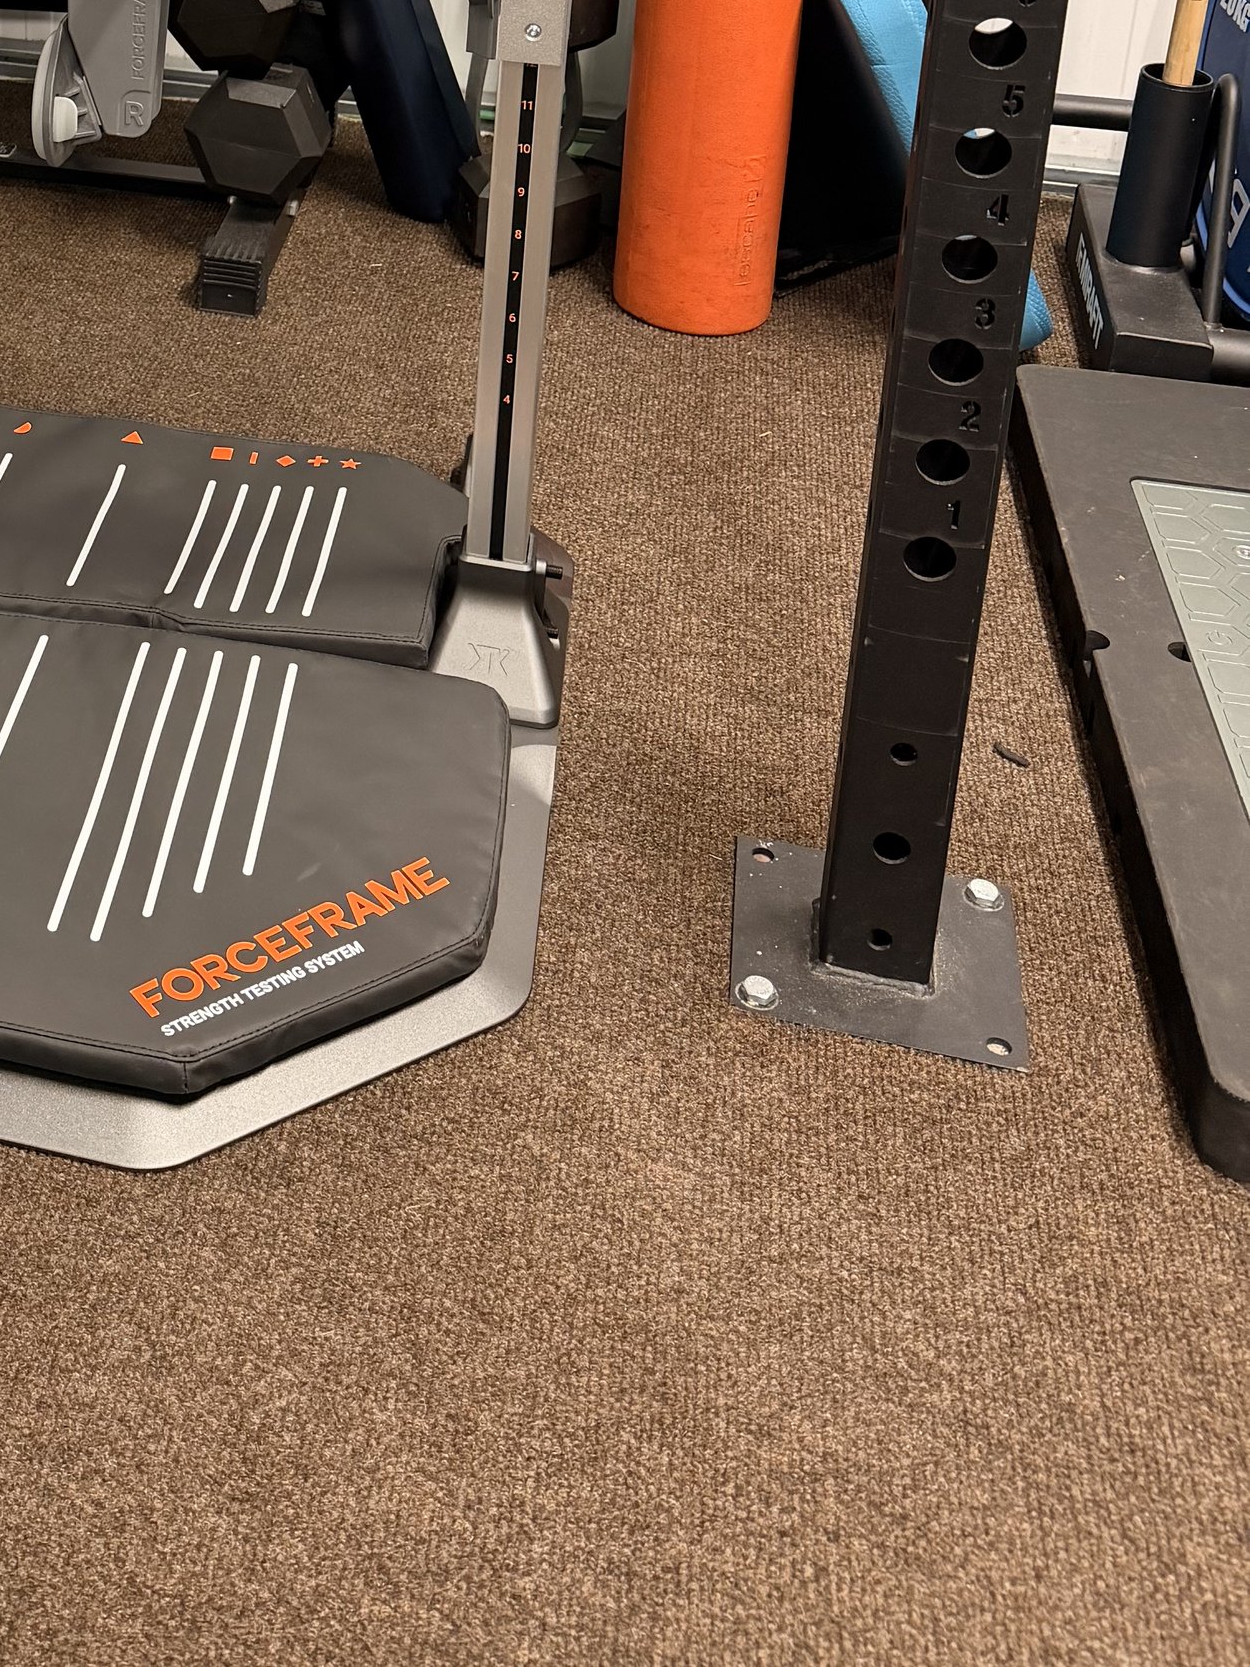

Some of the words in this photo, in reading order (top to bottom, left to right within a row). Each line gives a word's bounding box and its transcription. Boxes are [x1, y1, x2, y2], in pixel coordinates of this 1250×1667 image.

[521, 101, 534, 111] 11
[1002, 84, 1026, 118] 5
[124, 100, 145, 127] R
[517, 144, 531, 154] 10
[518, 187, 525, 197] 9
[986, 194, 1010, 226] 4
[514, 229, 522, 240] 8
[512, 271, 519, 281] 7
[509, 313, 516, 322] 6
[974, 297, 996, 330] 3
[506, 353, 514, 364] 5
[503, 394, 511, 404] 4
[959, 400, 982, 432] 2
[947, 499, 962, 530] 1
[129, 856, 451, 1018] FORCEFRAME
[160, 991, 244, 1038] STRENGTH
[240, 965, 307, 1002] TESTING
[304, 940, 366, 974] SYSTEM
